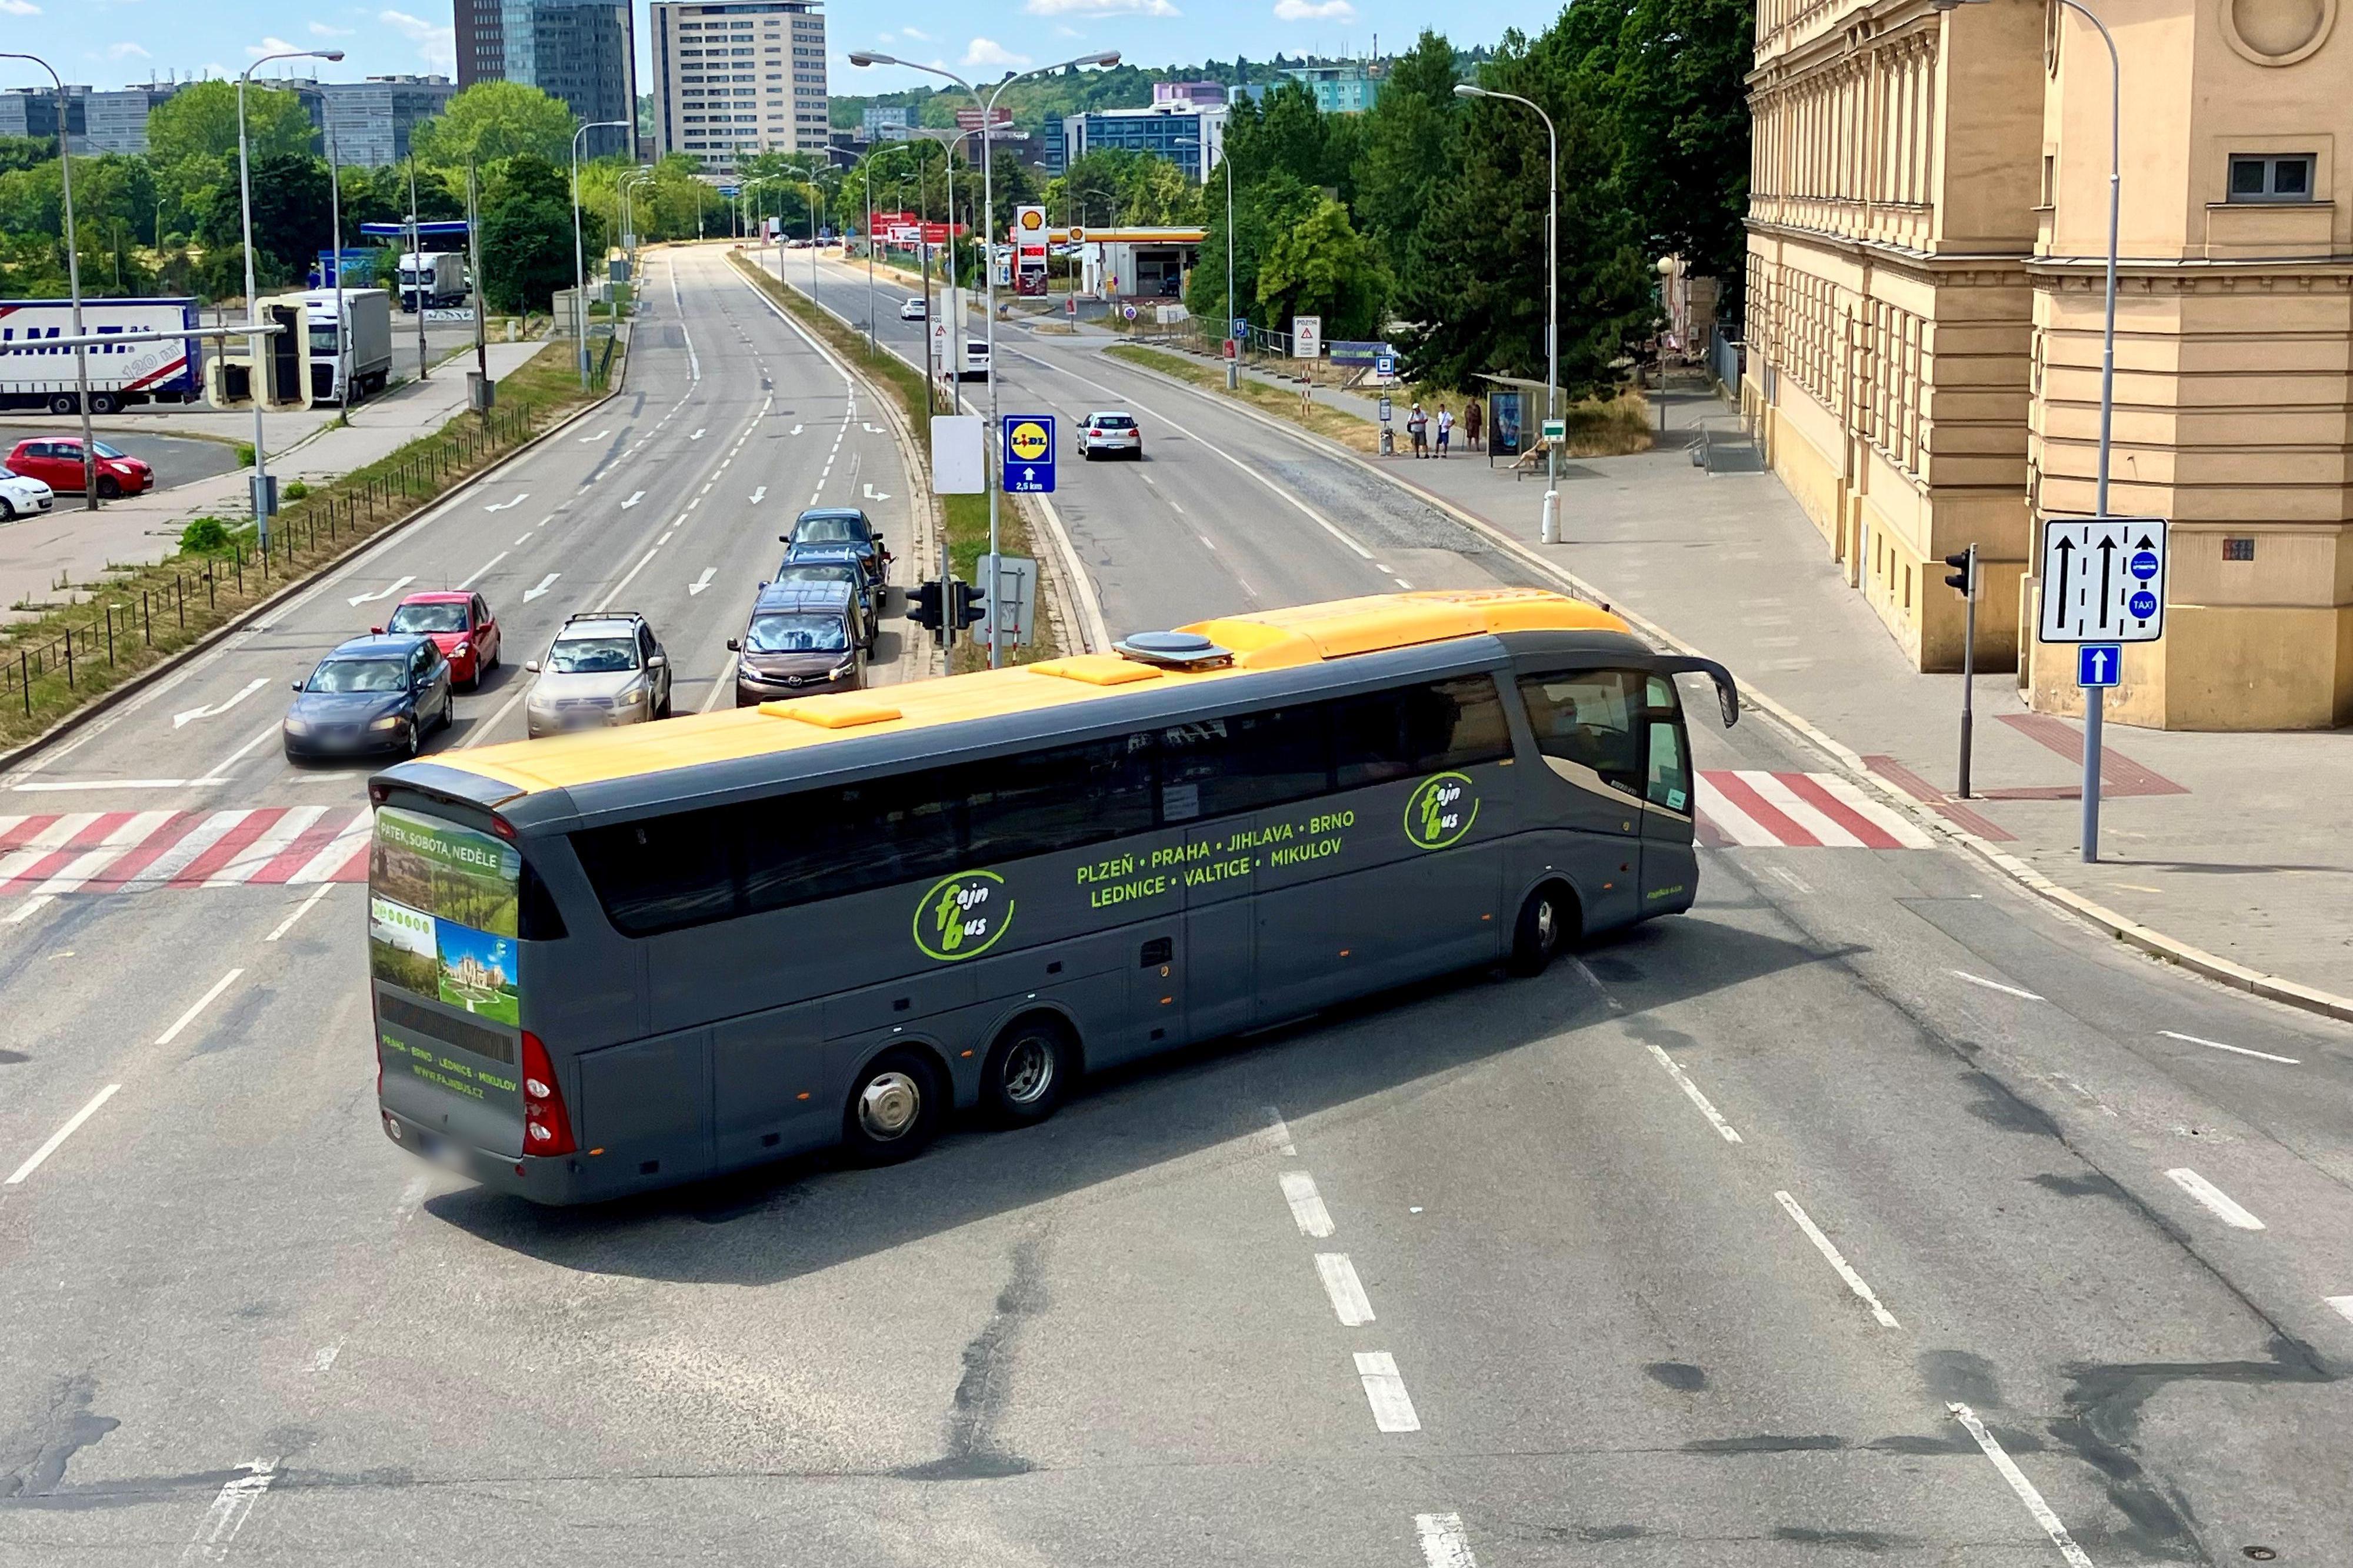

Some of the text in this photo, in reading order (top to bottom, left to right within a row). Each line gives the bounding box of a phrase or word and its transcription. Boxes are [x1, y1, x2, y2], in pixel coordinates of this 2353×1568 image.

[122, 354, 158, 379] 120
[1029, 482, 1042, 490] km
[2133, 600, 2154, 609] TAXI
[1421, 783, 1461, 823] fajn
[1425, 802, 1458, 840] bus
[452, 846, 497, 868] NEDĚLE
[1076, 810, 1354, 884] PLZEŇ PRAHA JIHLAVA BRNO
[1091, 838, 1342, 908] LEDNICE VALTICE MIKULOV
[935, 883, 989, 932] fajn
[942, 906, 986, 951] bus
